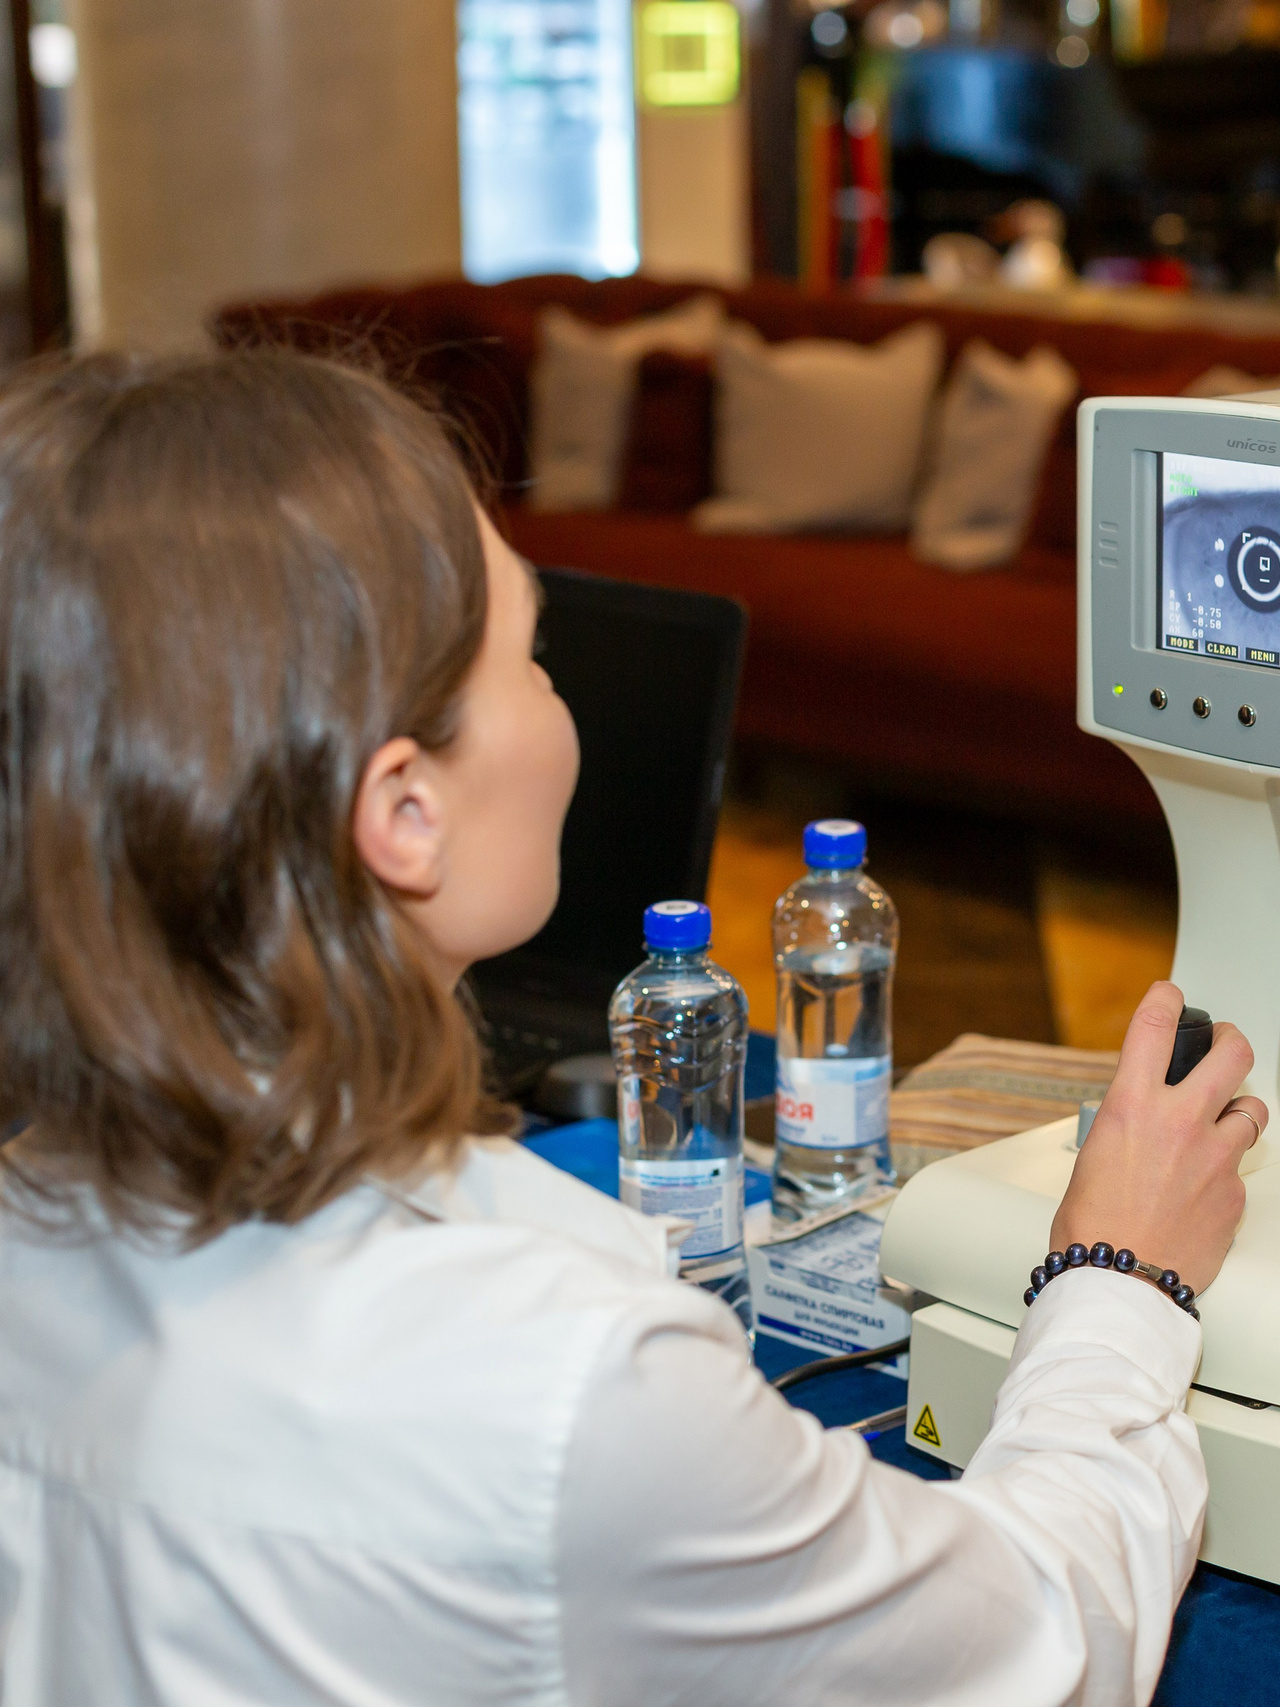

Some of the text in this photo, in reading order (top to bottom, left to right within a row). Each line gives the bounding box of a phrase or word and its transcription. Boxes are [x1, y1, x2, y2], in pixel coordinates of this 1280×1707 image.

[1226, 437, 1277, 454] unicos
[1187, 592, 1192, 602] 1
[1192, 605, 1222, 618] -0.75
[1192, 617, 1222, 630] -0.50
[1192, 628, 1204, 639] 60
[1170, 637, 1195, 650] MODE
[1207, 643, 1237, 657] CLEAR
[1250, 650, 1275, 663] MENU
